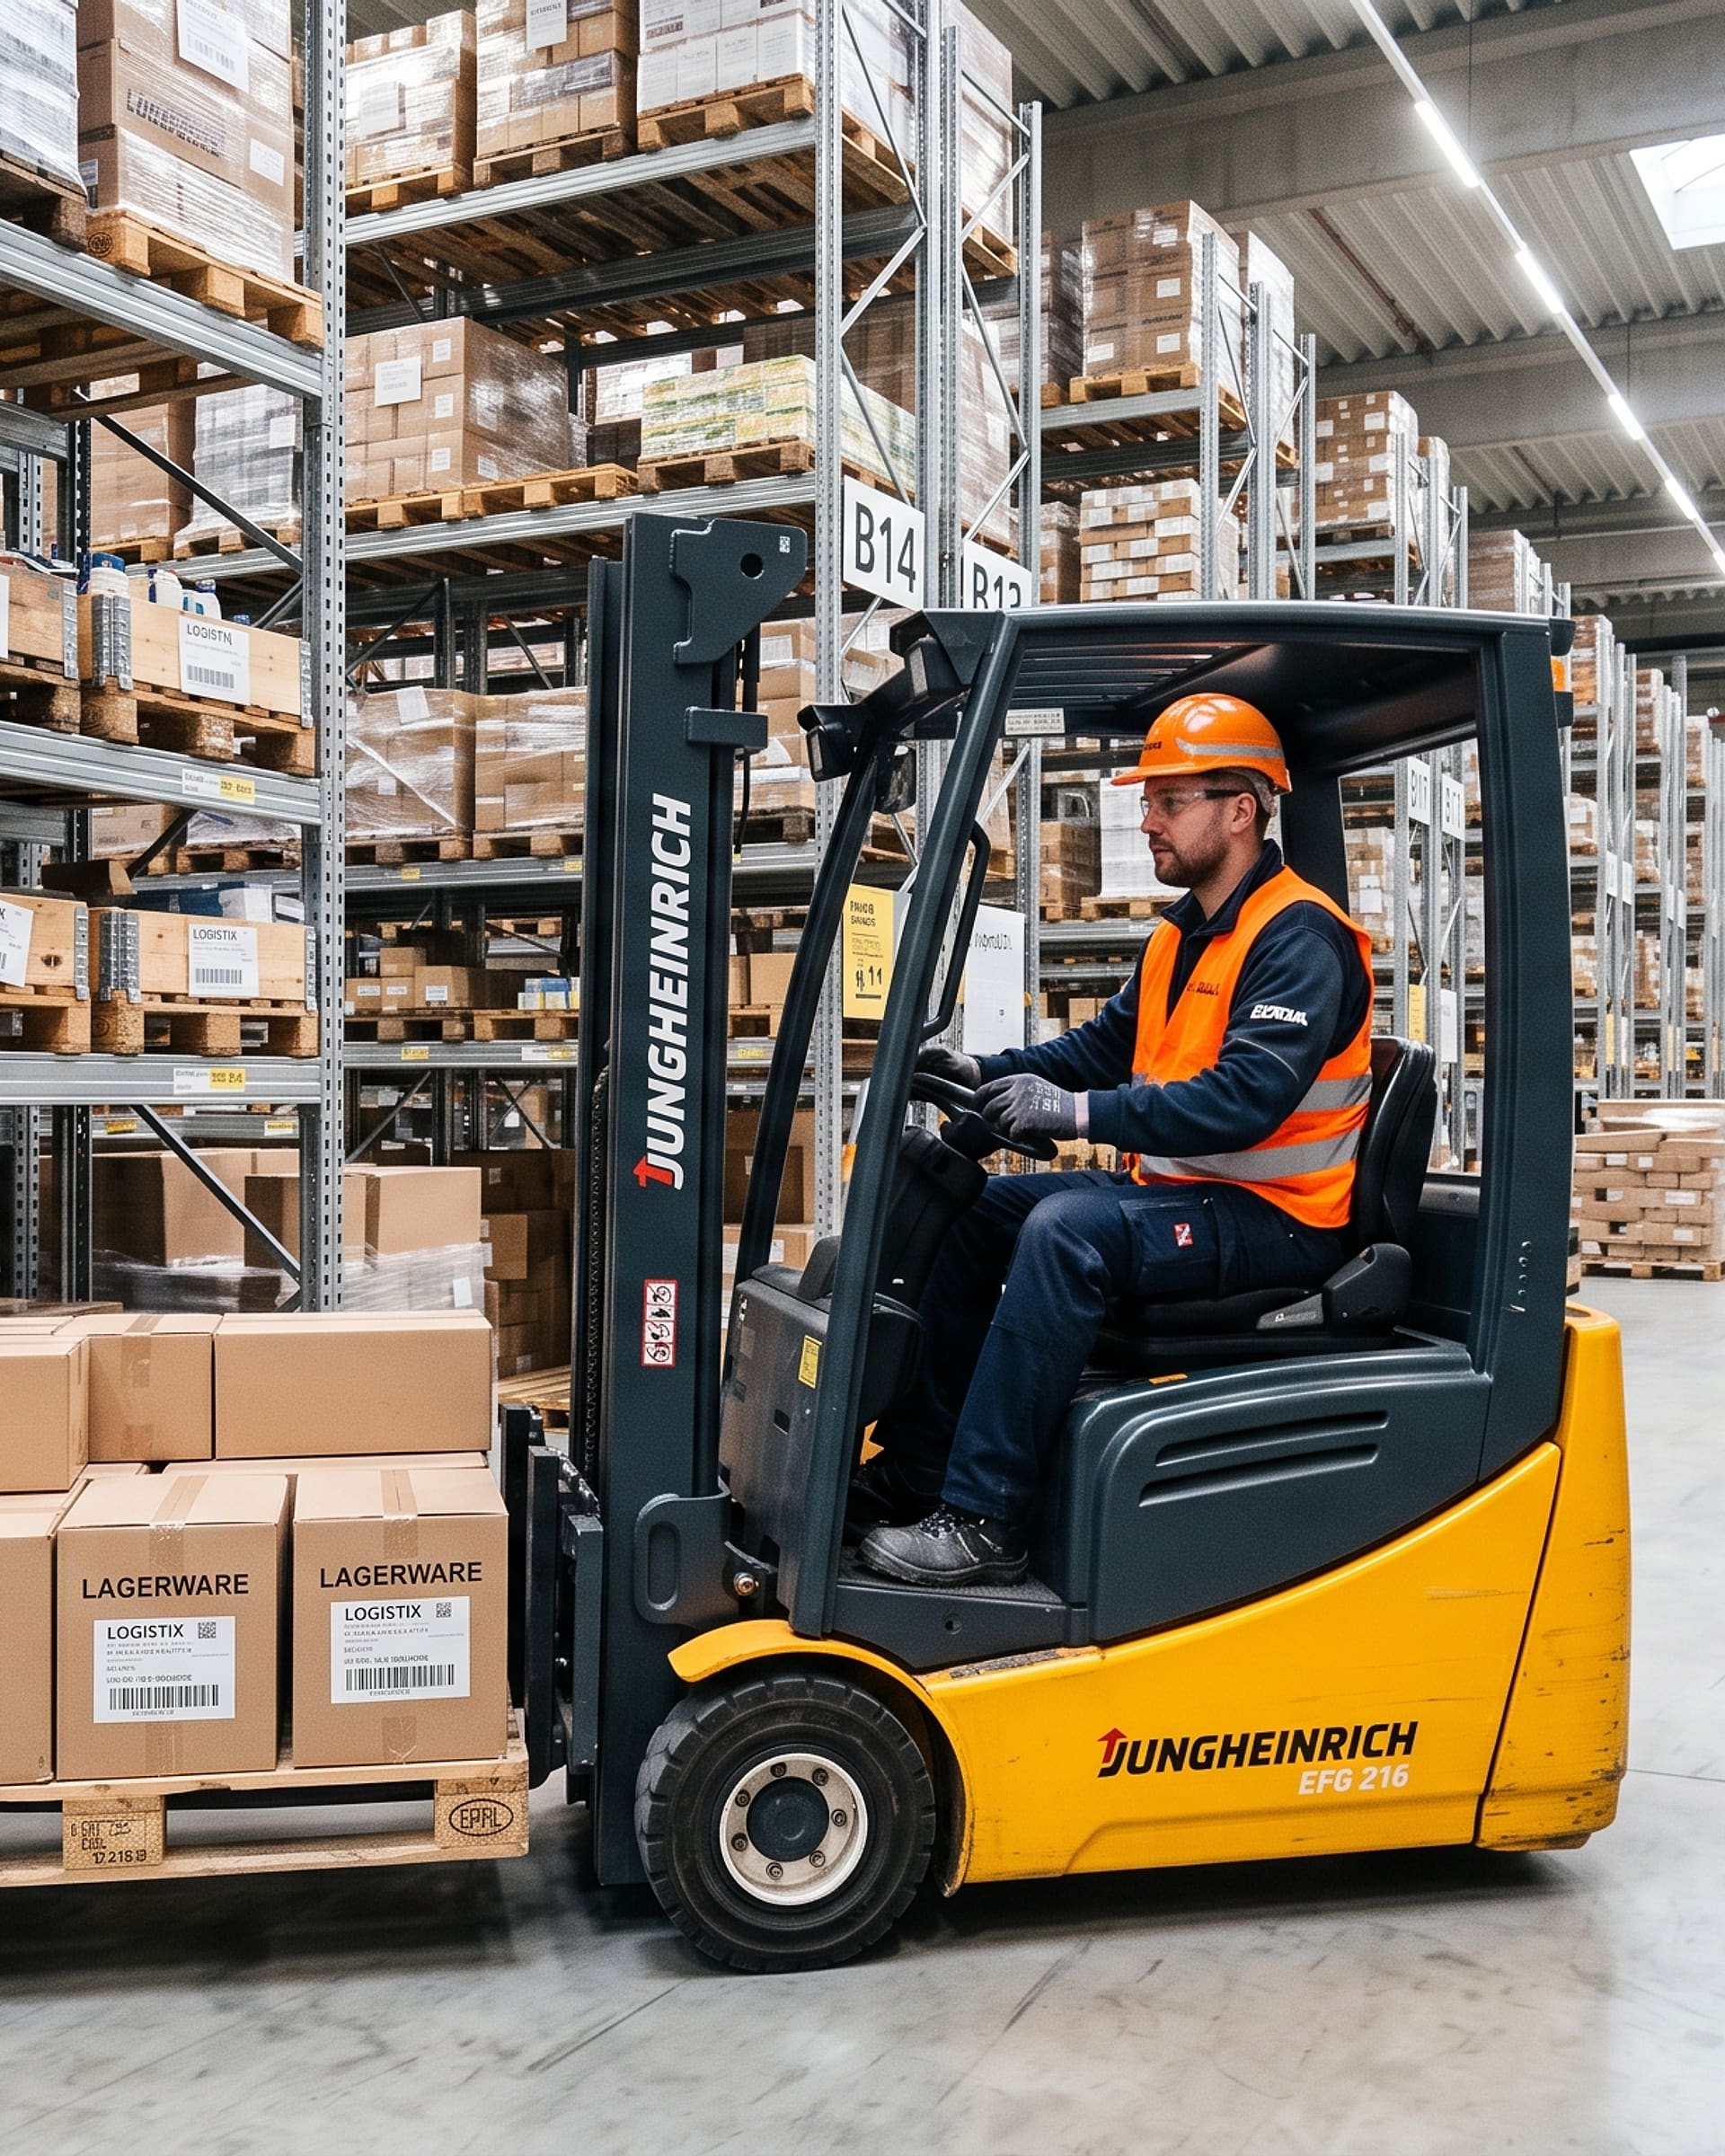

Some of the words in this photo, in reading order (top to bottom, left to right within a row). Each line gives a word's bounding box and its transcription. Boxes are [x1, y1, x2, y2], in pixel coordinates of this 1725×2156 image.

[855, 501, 916, 594] B14
[192, 928, 237, 941] LOGISTIX
[644, 792, 691, 1190] JUNGHEINRICH
[82, 1574, 249, 1599] LAGERWARE
[320, 1561, 482, 1588] LAGERWARE
[345, 1604, 421, 1621] LOGISTIX
[107, 1623, 184, 1639] LOGISTIX
[1096, 1721, 1419, 1778] JUNGHEINRICH
[1298, 1768, 1353, 1795] EFG
[1358, 1763, 1409, 1790] 216
